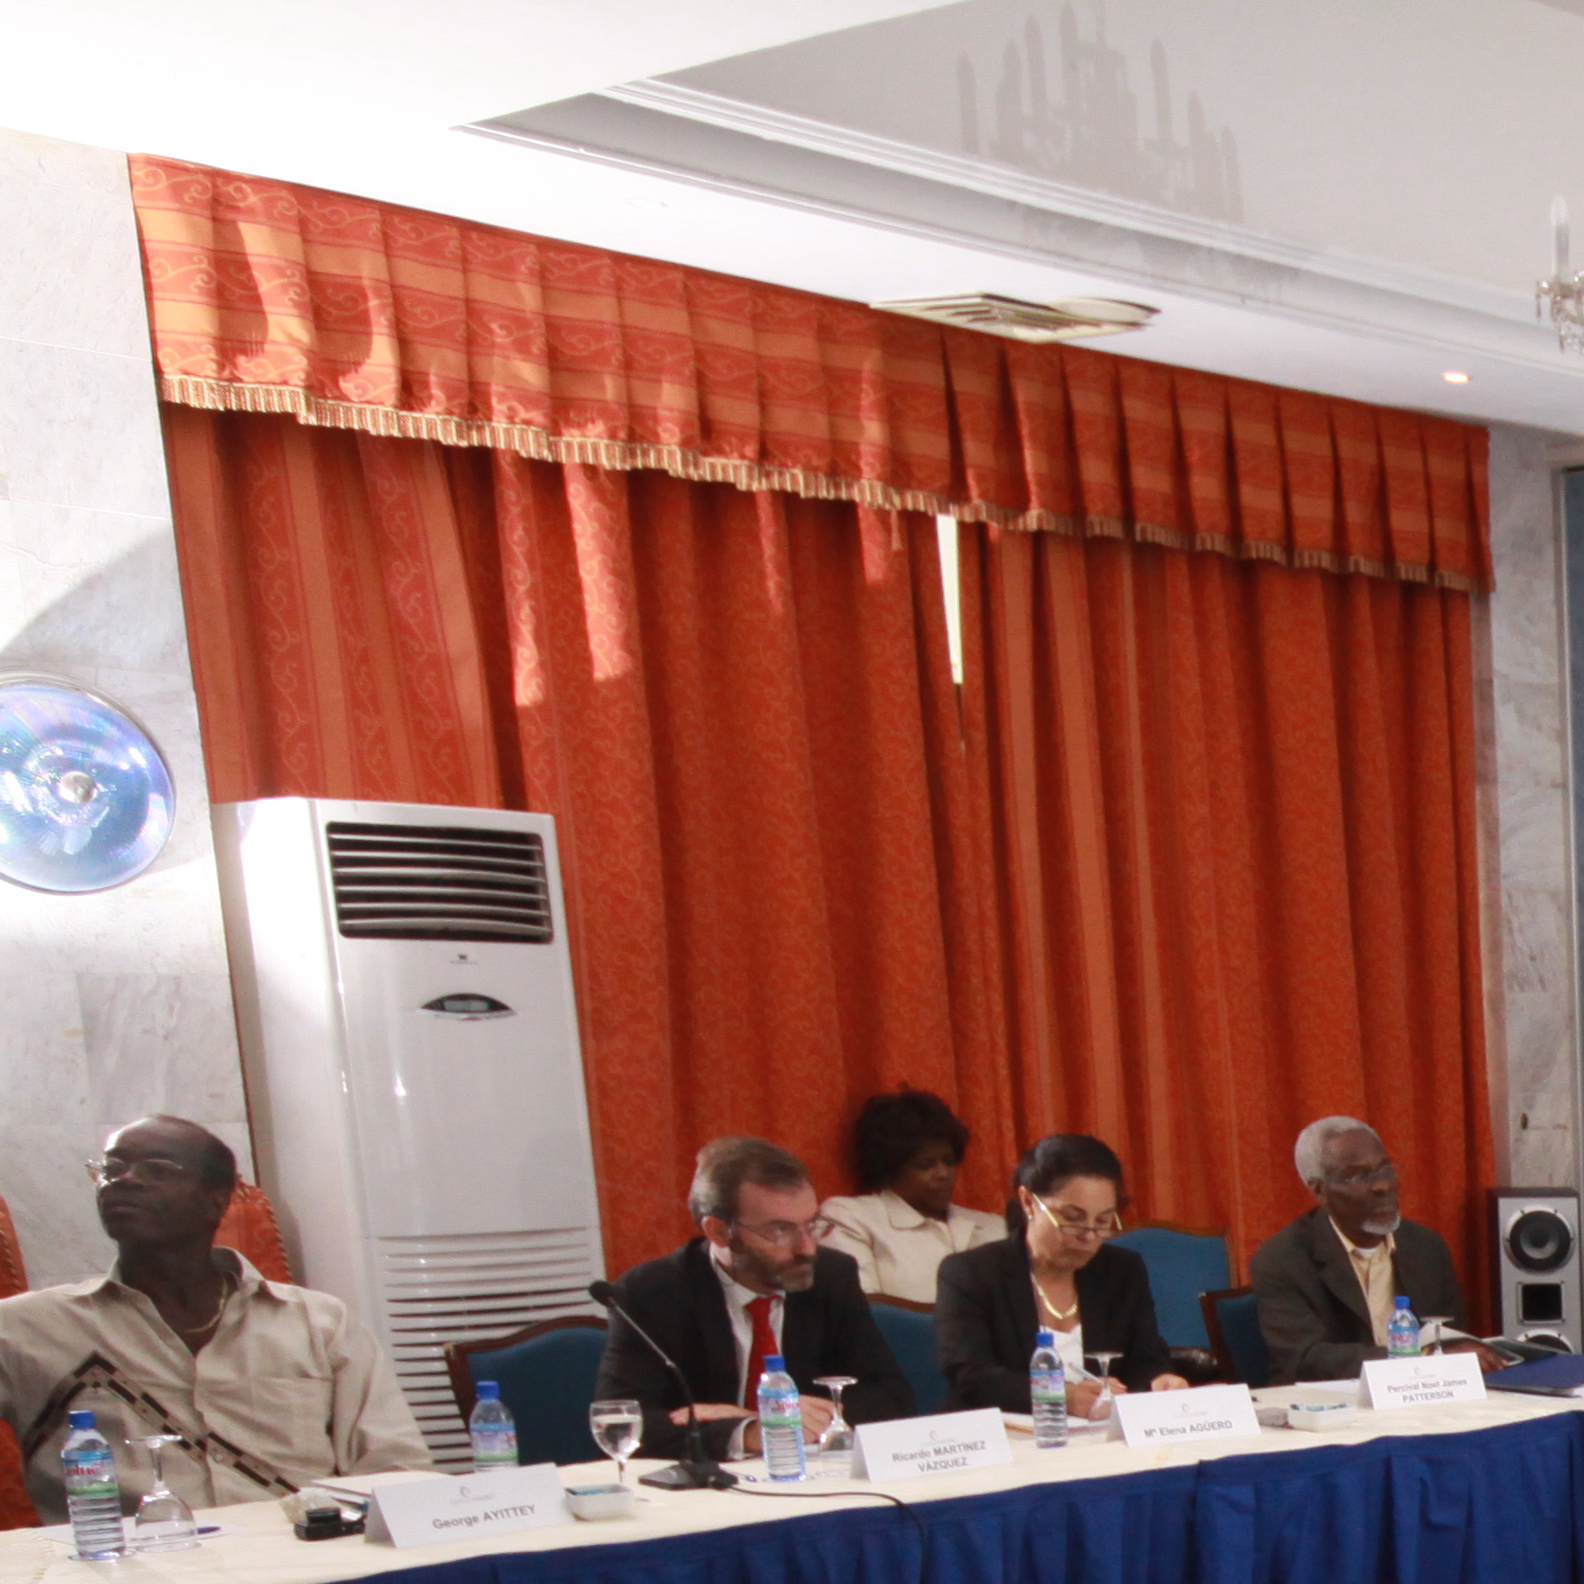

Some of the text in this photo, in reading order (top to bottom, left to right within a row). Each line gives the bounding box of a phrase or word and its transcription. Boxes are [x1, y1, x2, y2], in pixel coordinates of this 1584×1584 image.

[1402, 1391, 1455, 1403] PATTERSON
[1160, 1425, 1187, 1436] Elena
[892, 1449, 932, 1463] Ricardo
[432, 1504, 536, 1530] George AYITTEY
